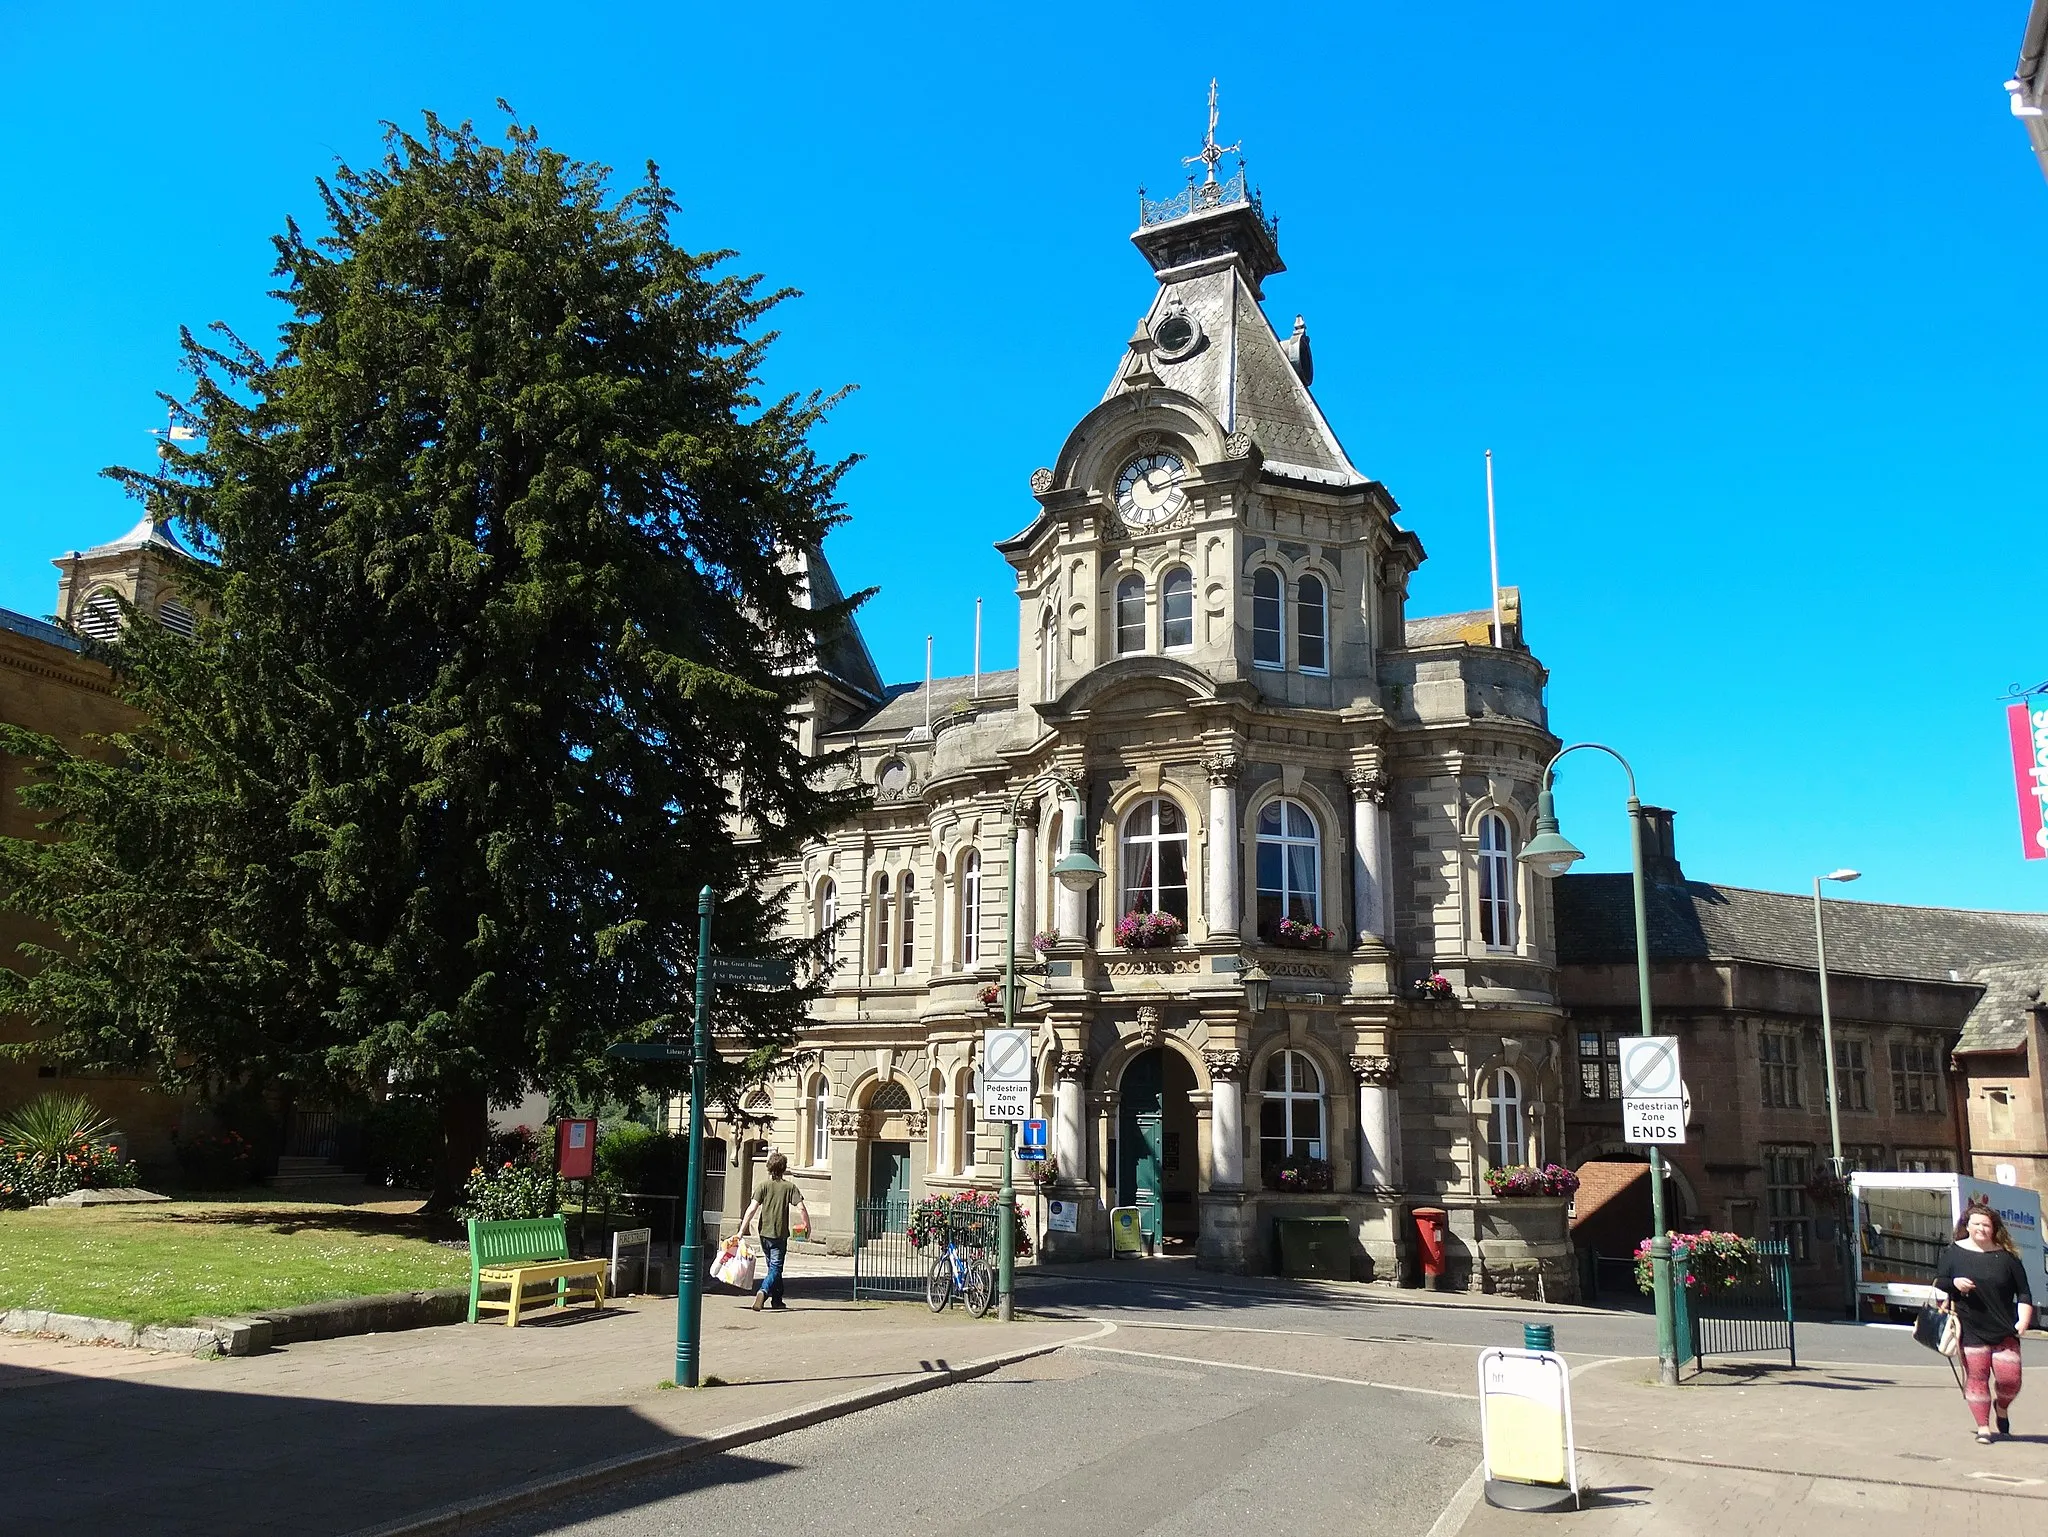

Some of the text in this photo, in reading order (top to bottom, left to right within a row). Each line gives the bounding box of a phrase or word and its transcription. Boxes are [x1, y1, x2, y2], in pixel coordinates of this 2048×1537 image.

[666, 1048, 686, 1056] Library
[986, 1084, 1028, 1092] Pedestrian
[997, 1093, 1017, 1101] Zone
[989, 1105, 1025, 1116] ENDS
[1626, 1102, 1679, 1111] Pedestrian
[1641, 1112, 1665, 1121] Zone
[1632, 1126, 1677, 1138] ENDS
